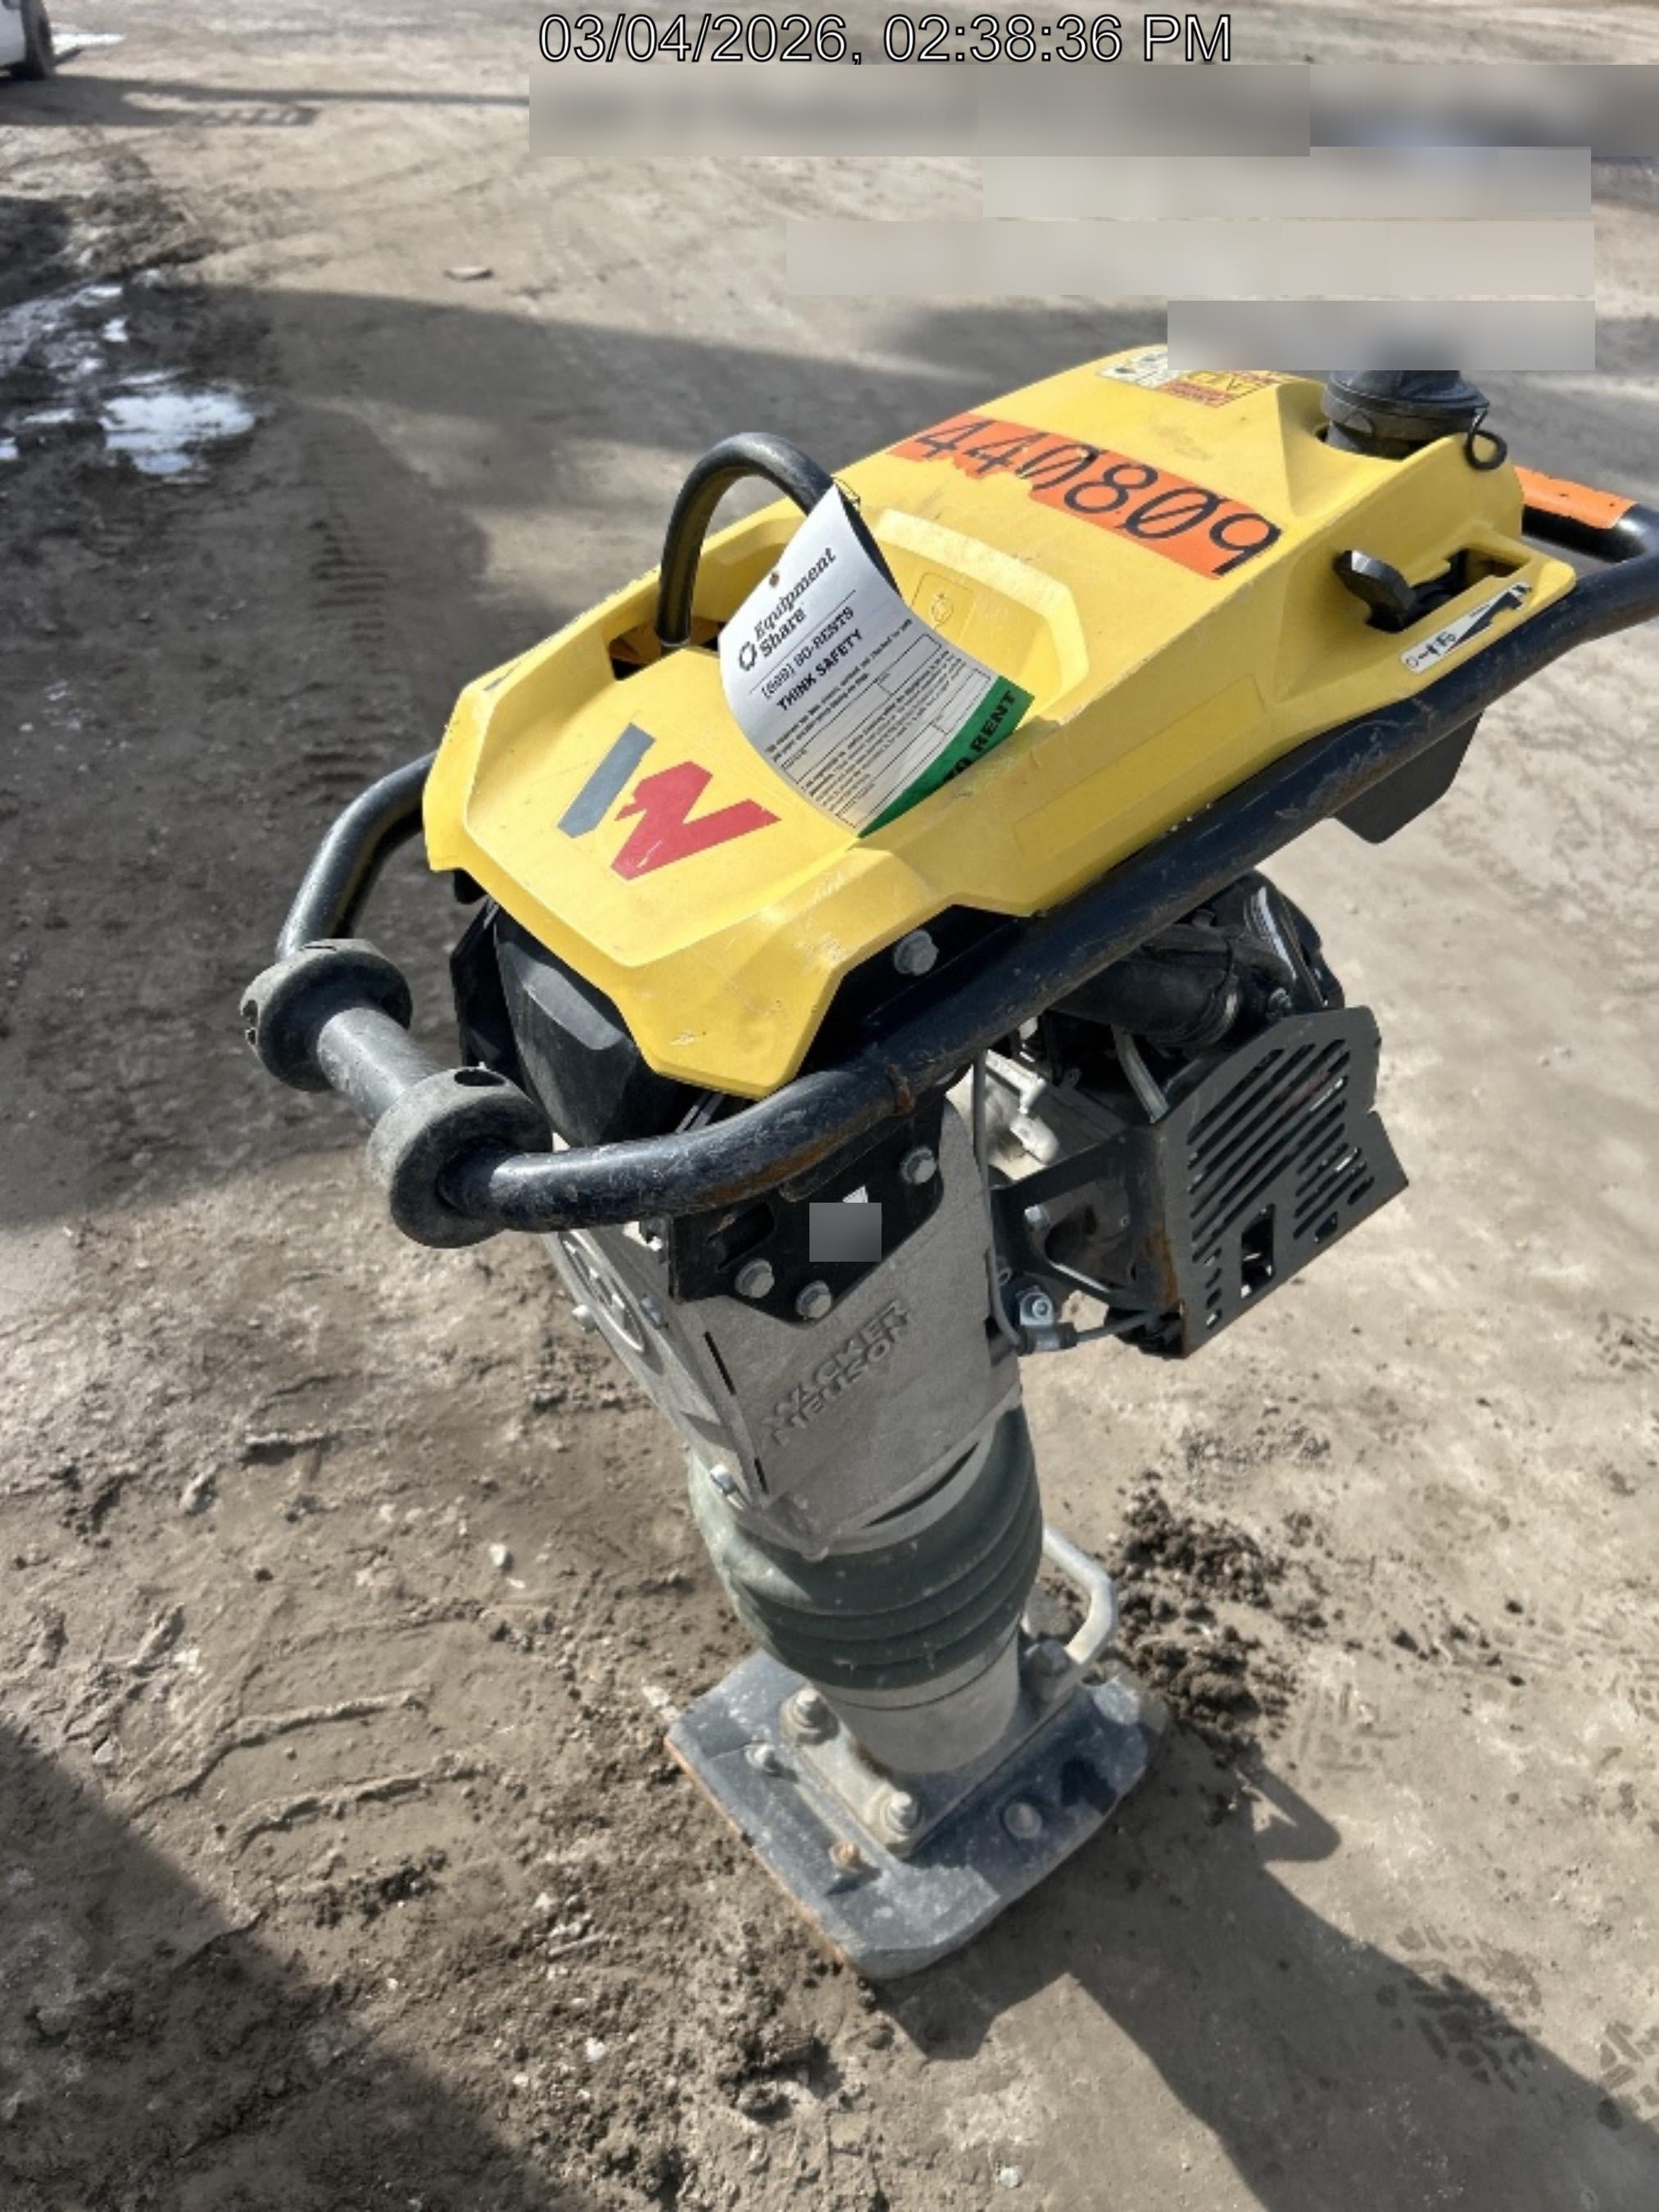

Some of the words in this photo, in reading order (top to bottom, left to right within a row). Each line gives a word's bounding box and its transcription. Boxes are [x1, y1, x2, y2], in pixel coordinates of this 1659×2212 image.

[913, 419, 1283, 575] 440809
[755, 547, 836, 641] Equipment
[759, 607, 806, 657] Share
[776, 673, 817, 711] THINK
[815, 628, 863, 677] SAFETY
[970, 690, 1015, 752] RENT
[759, 1299, 909, 1427] WACKER
